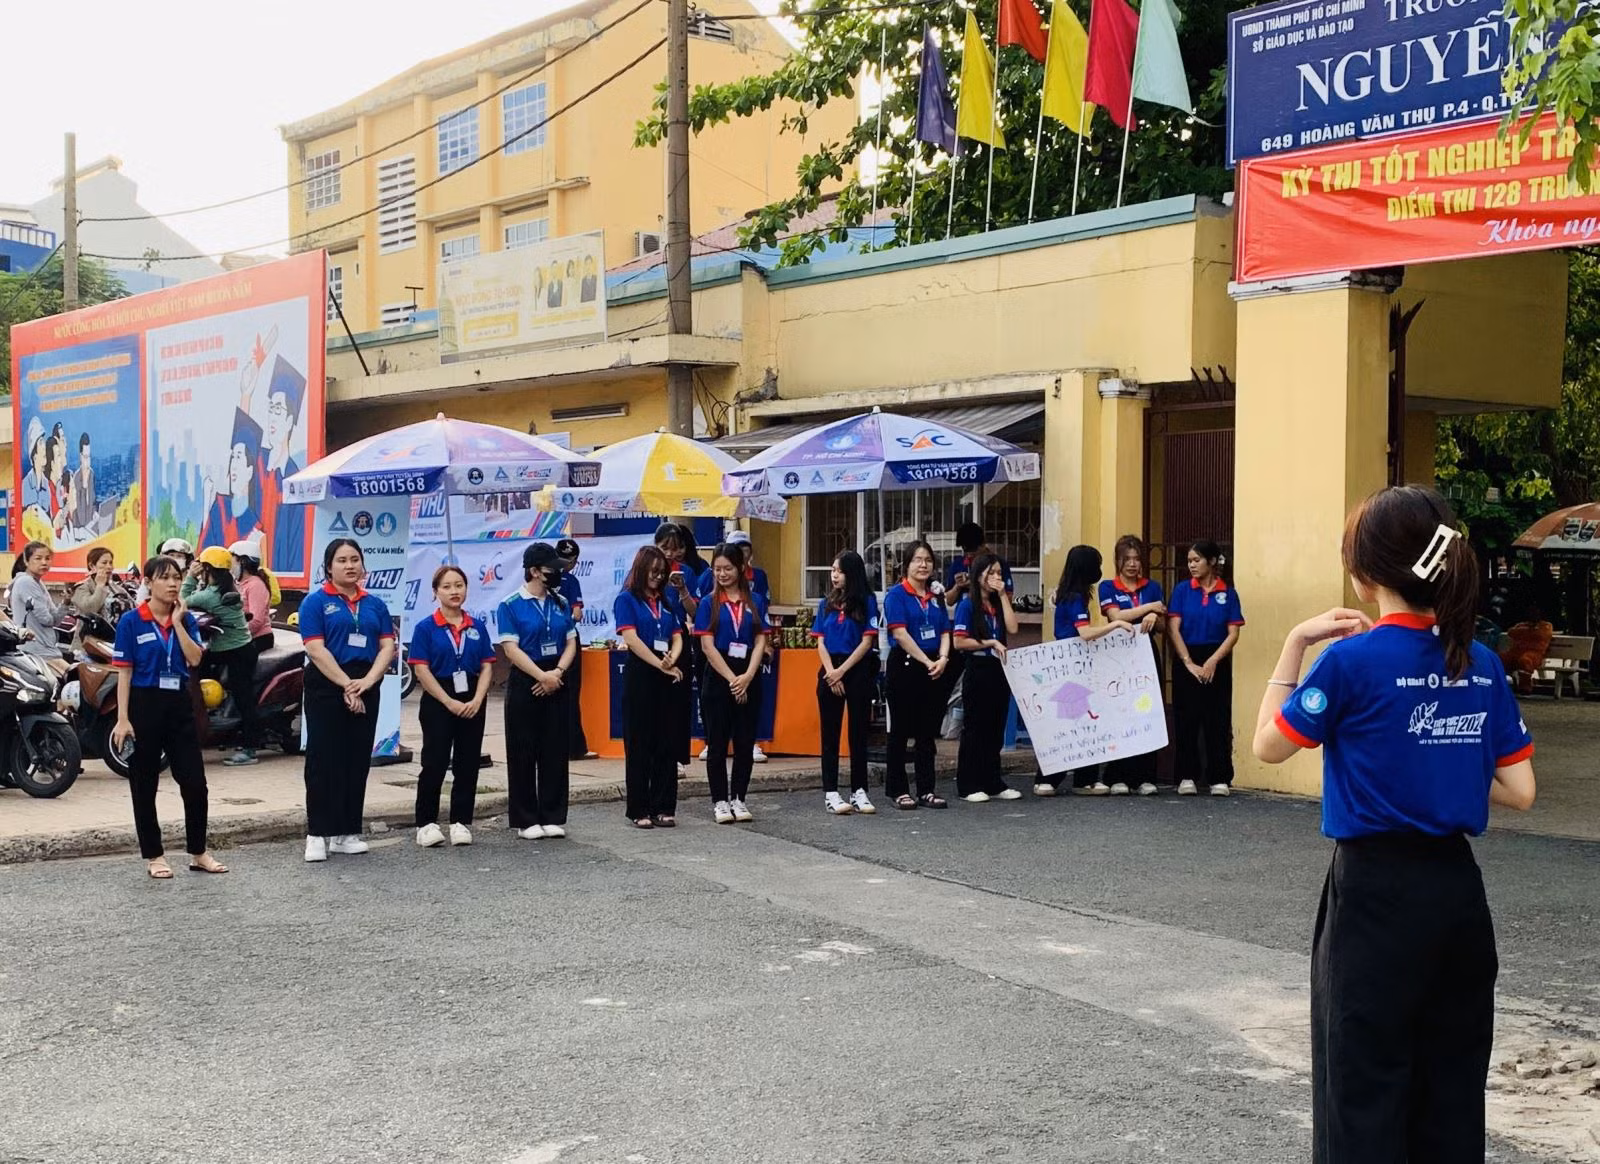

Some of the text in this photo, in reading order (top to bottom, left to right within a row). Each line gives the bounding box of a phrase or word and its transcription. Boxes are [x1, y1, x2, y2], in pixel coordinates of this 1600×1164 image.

[1241, 21, 1264, 38] UBND
[1265, 14, 1292, 32] THÀNH
[1293, 5, 1310, 25] PHỐ
[1252, 18, 1355, 53] SỞ GIÁO DỤC VÀ ĐÀO TẠO
[1261, 133, 1293, 152] 649
[1300, 121, 1356, 146] HOÀNG
[1361, 113, 1395, 133] VĂN
[1401, 106, 1436, 126] THỤ
[1442, 99, 1470, 119] P.4
[1281, 165, 1313, 199] KỲ
[1321, 160, 1362, 193] THI
[1369, 142, 1420, 186] TỐT
[1427, 133, 1531, 178] NGHIỆP
[1387, 187, 1436, 222] ĐIỂM
[1441, 187, 1478, 215] THI
[1483, 180, 1522, 209] 128
[1477, 217, 1554, 246] Khóa
[352, 477, 426, 496] 18001568
